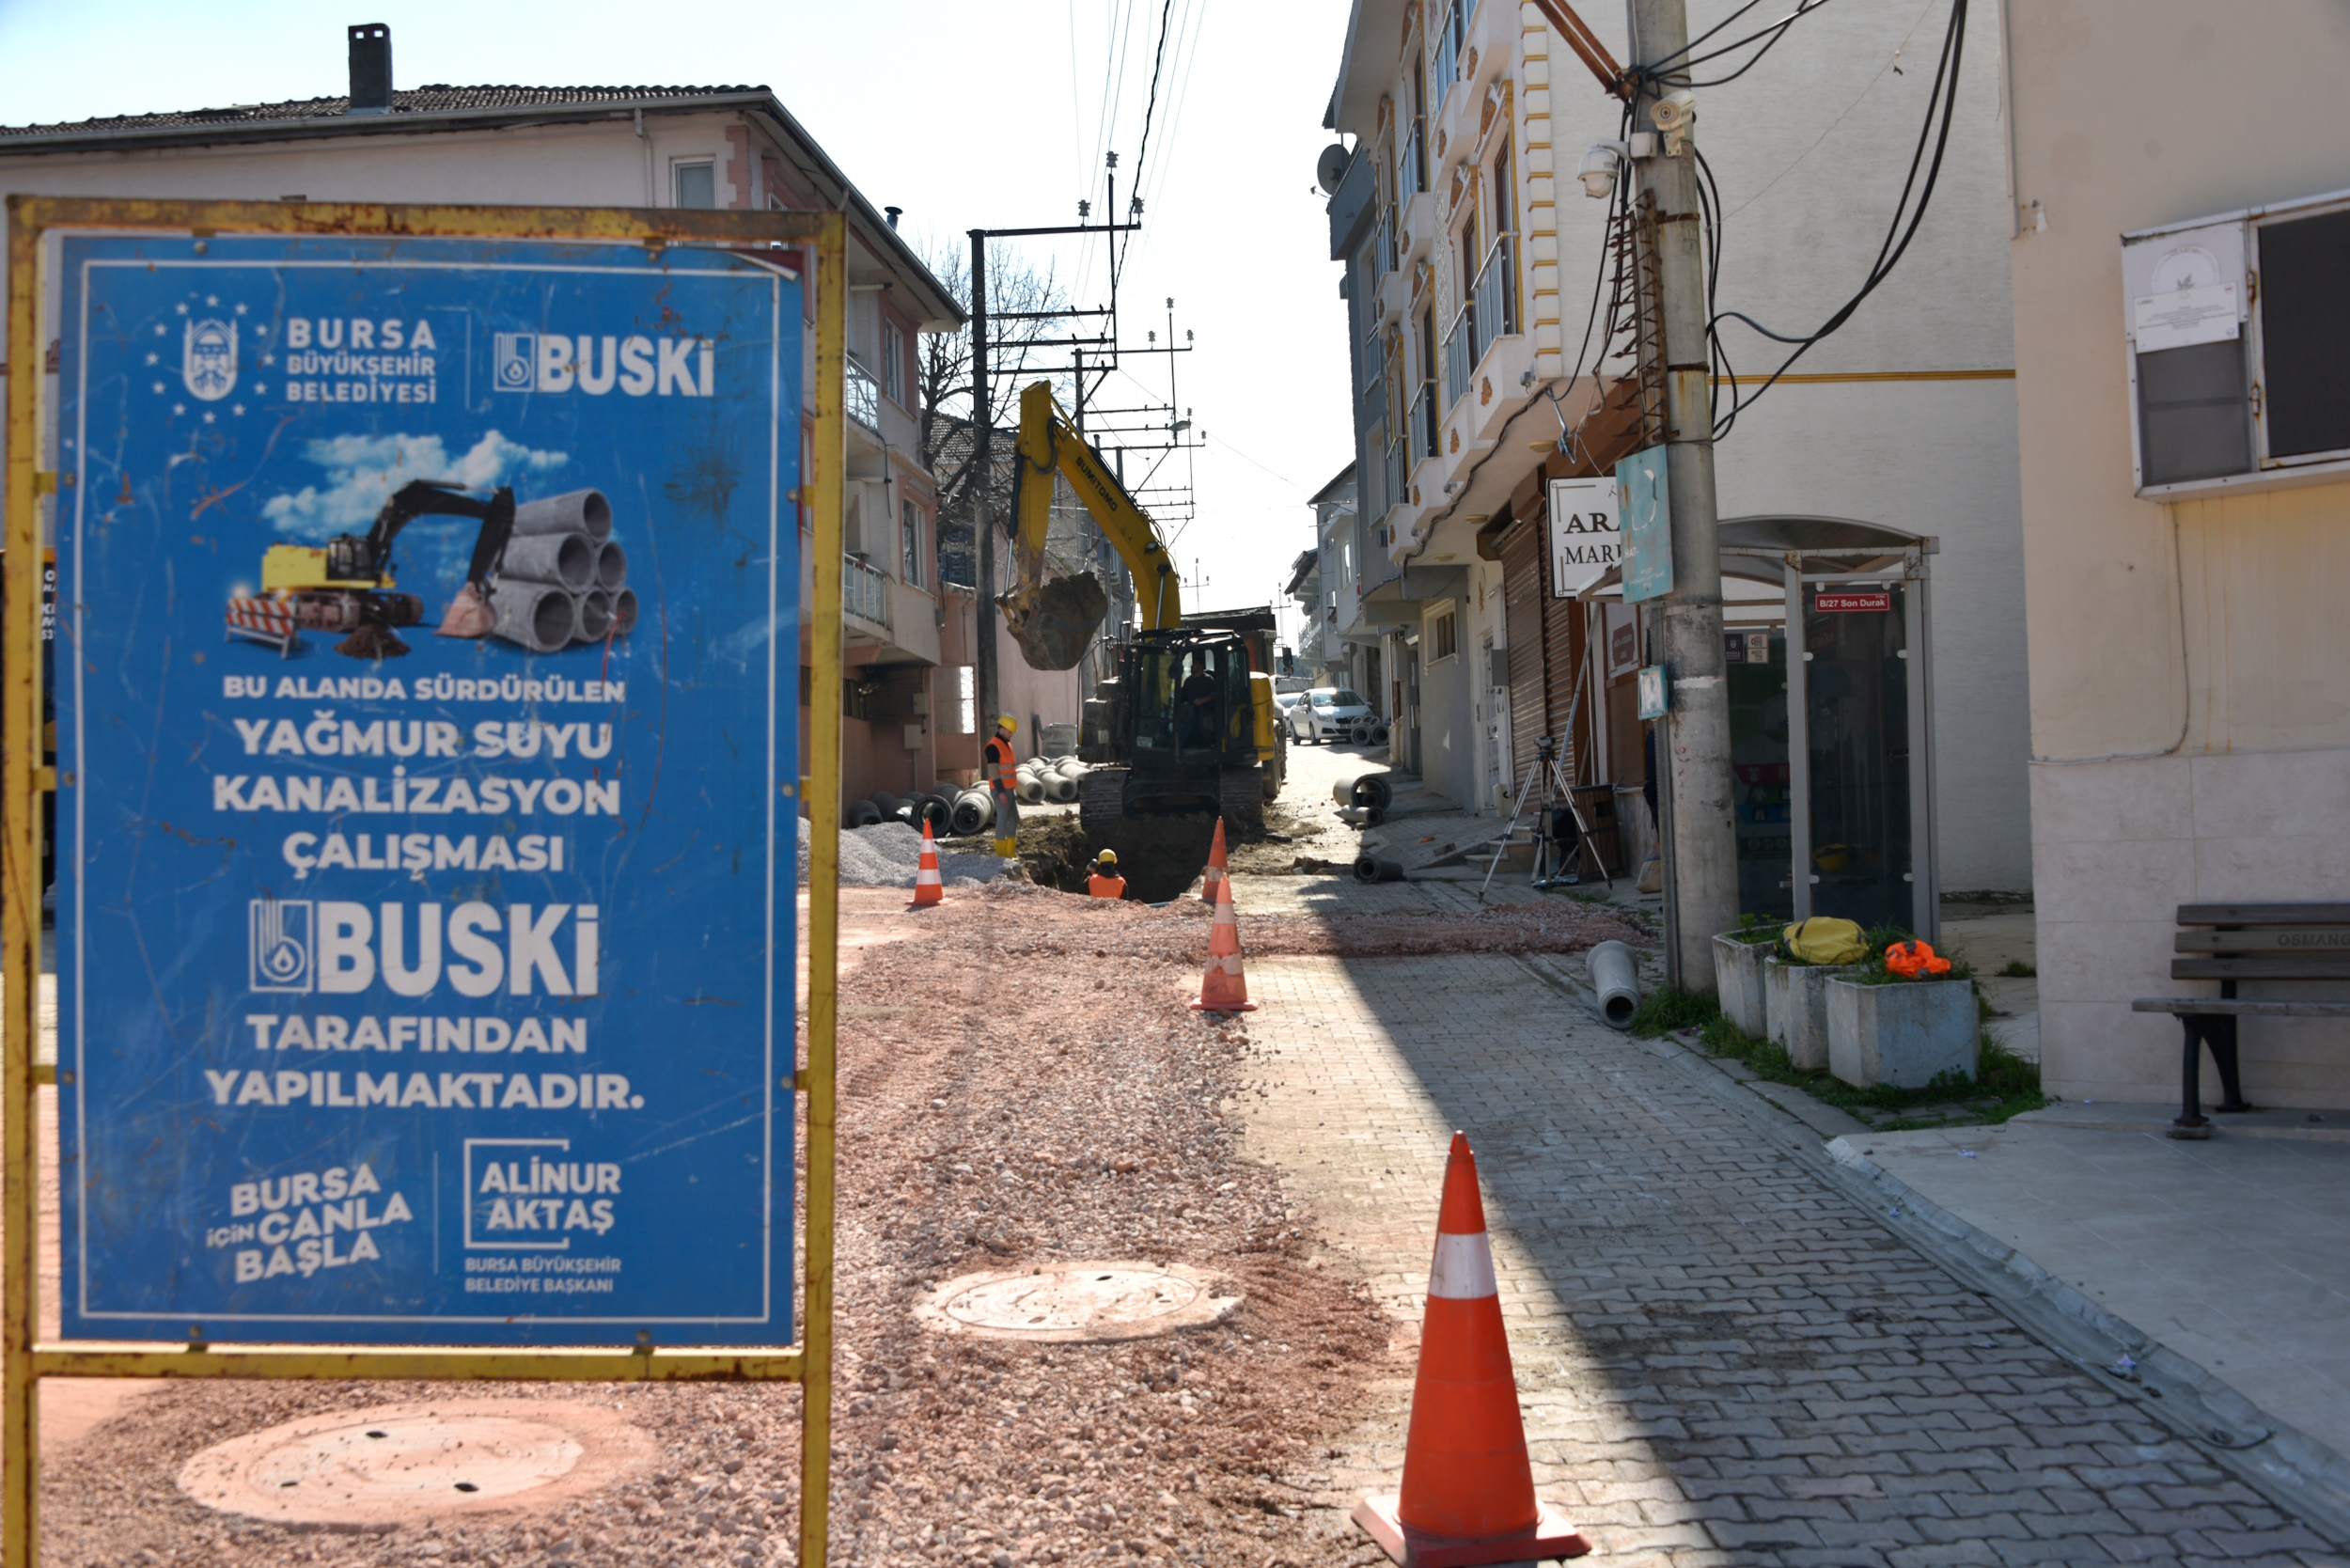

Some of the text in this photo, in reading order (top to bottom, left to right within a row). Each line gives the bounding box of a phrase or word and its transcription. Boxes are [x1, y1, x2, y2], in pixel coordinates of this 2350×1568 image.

[288, 318, 436, 350] BURSA
[287, 378, 436, 403] BELEDİYESİ
[1075, 456, 1118, 512] SUMITOMO
[1820, 598, 1886, 608] B/27 Son Durak
[224, 672, 626, 703] BU ALANDA SÜRDÜRÜLEN
[234, 710, 461, 758] YAĞMUR
[213, 764, 620, 816] KANALİZASYON
[283, 831, 564, 881] ÇALIŞMASI
[246, 1013, 588, 1054] TARAFINDAN
[205, 1069, 645, 1110] YAPILMAKTADIR.
[231, 1163, 381, 1217] BURSA
[479, 1155, 621, 1194] ALİNUR
[258, 1191, 414, 1245] CANLA
[486, 1199, 615, 1236] AKTAŞ
[236, 1230, 381, 1283] BAŞLA
[465, 1255, 622, 1275] BURSA BÜYÜKŞEHİR
[465, 1276, 613, 1295] BELEDİYE BAŞKANI
